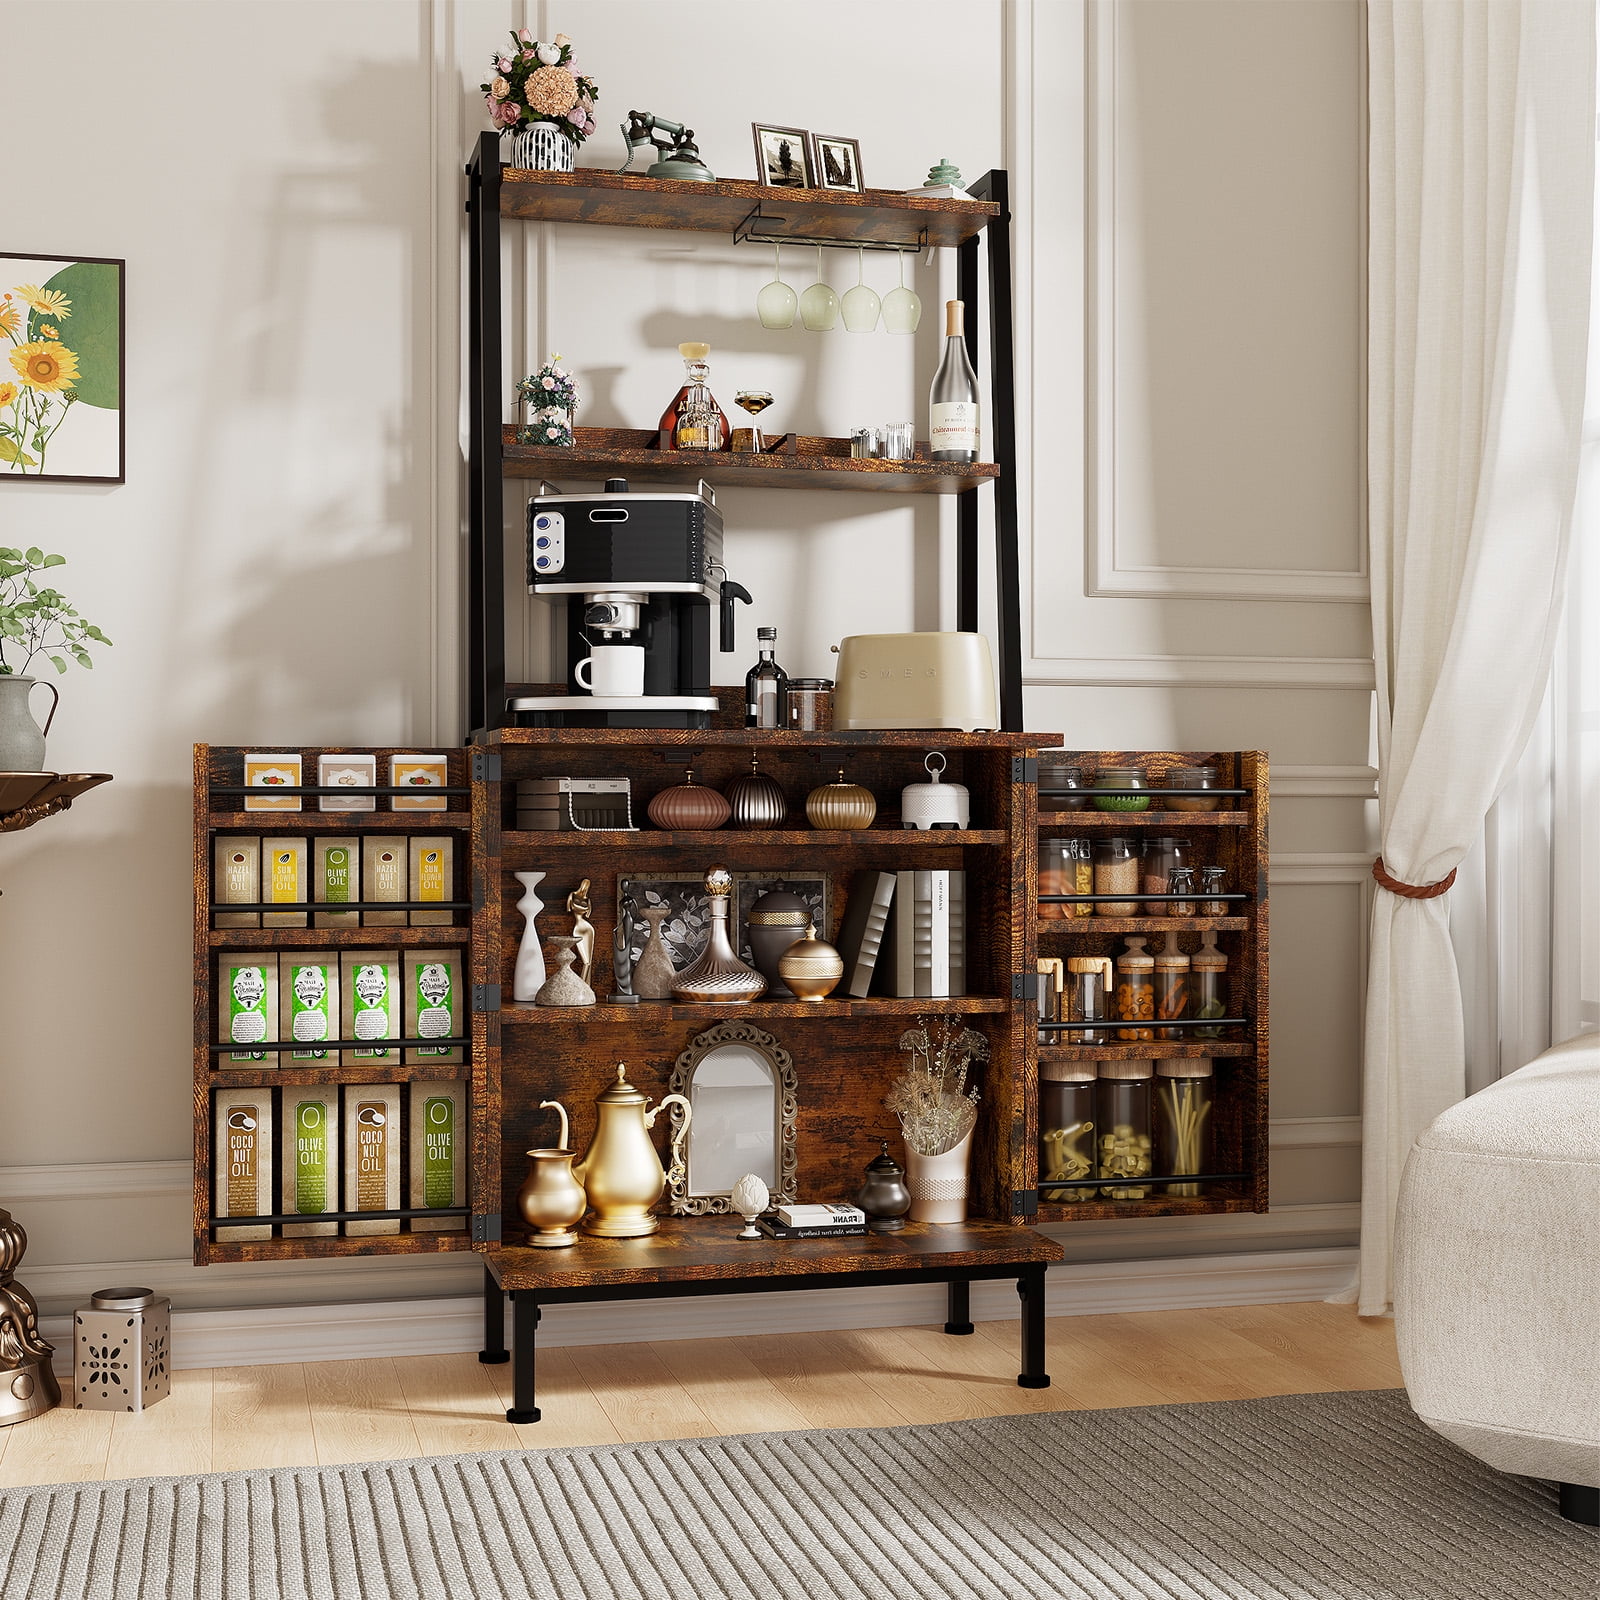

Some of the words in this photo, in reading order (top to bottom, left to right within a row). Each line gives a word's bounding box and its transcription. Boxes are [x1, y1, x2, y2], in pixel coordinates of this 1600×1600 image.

[858, 667, 937, 680] SMEG
[227, 865, 249, 874] HAZEL
[277, 866, 292, 874] SUN
[327, 868, 347, 877] OLIVE
[376, 864, 397, 873] HAZEL
[424, 864, 439, 873] SUN
[231, 874, 245, 882] NUT
[328, 876, 346, 886] OIL
[380, 872, 394, 880] NUT
[230, 882, 247, 891] OIL
[276, 882, 293, 891] OIL
[379, 880, 394, 889] OIL
[423, 880, 439, 889] OIL
[230, 1135, 254, 1149] COCO
[360, 1130, 383, 1145] COCO
[427, 1132, 451, 1147] OLIVE
[298, 1137, 323, 1151] OLIVE
[233, 1149, 251, 1162] NUT
[363, 1144, 380, 1158] NUT
[428, 1146, 449, 1161] OIL
[300, 1151, 321, 1166] OIL
[231, 1162, 253, 1177] OIL
[361, 1158, 382, 1172] OIL
